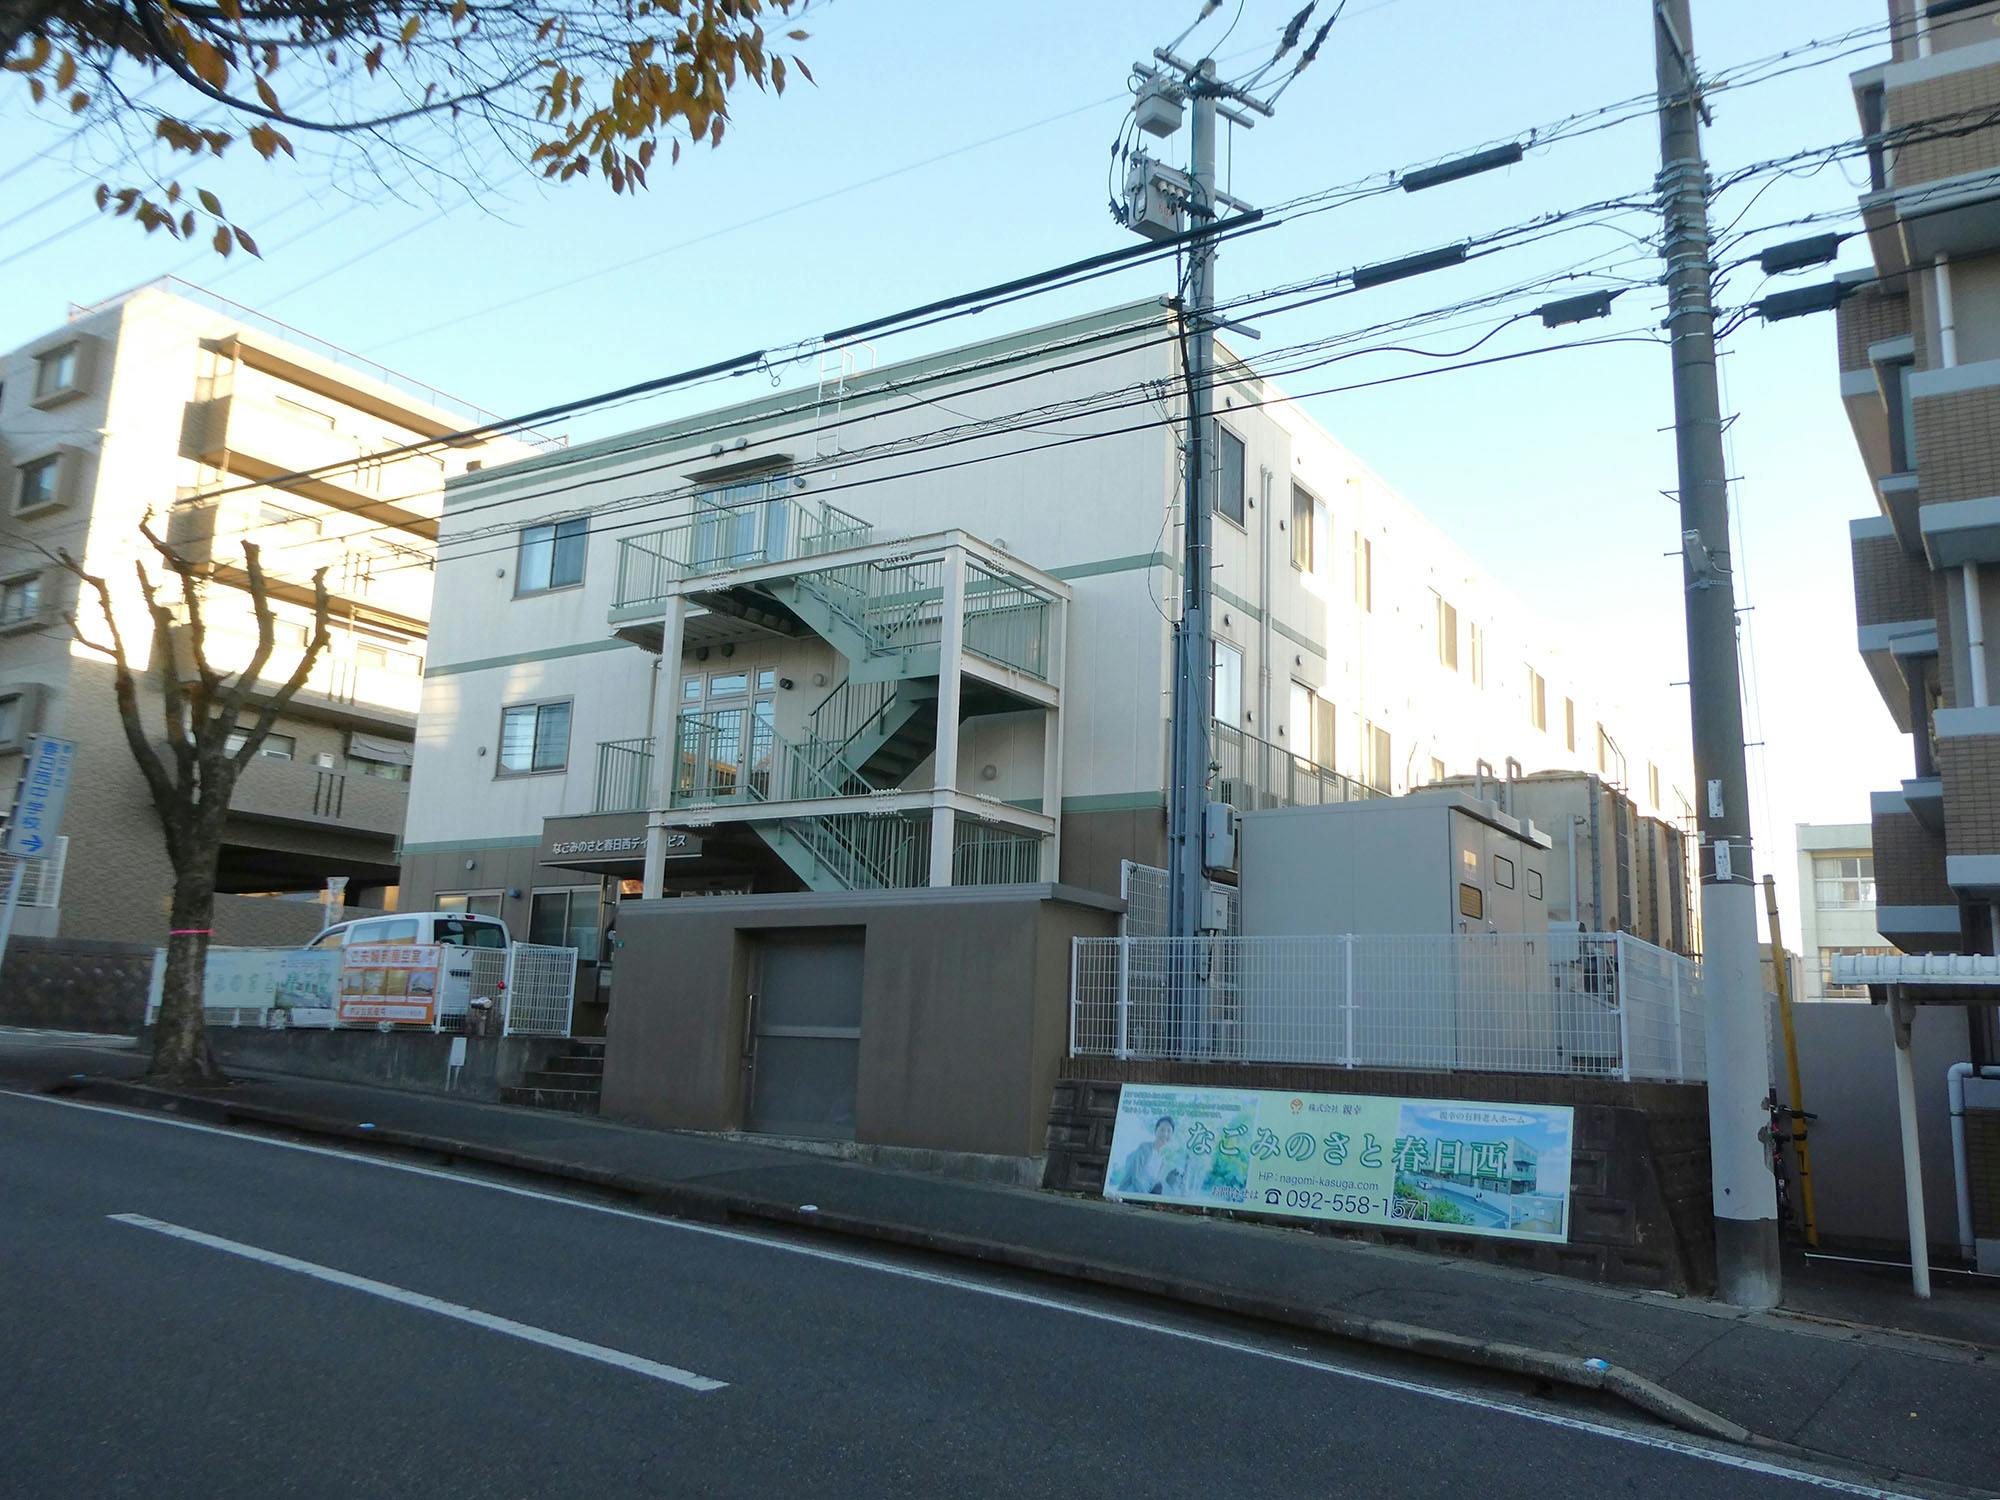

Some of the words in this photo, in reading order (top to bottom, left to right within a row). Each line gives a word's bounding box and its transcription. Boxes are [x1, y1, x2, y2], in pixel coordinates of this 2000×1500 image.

[552, 834, 687, 855] なごみのさと春日西デイビス
[1186, 1121, 1509, 1181] なごみのさと春日西
[1285, 1189, 1430, 1222] 092-558-1571
